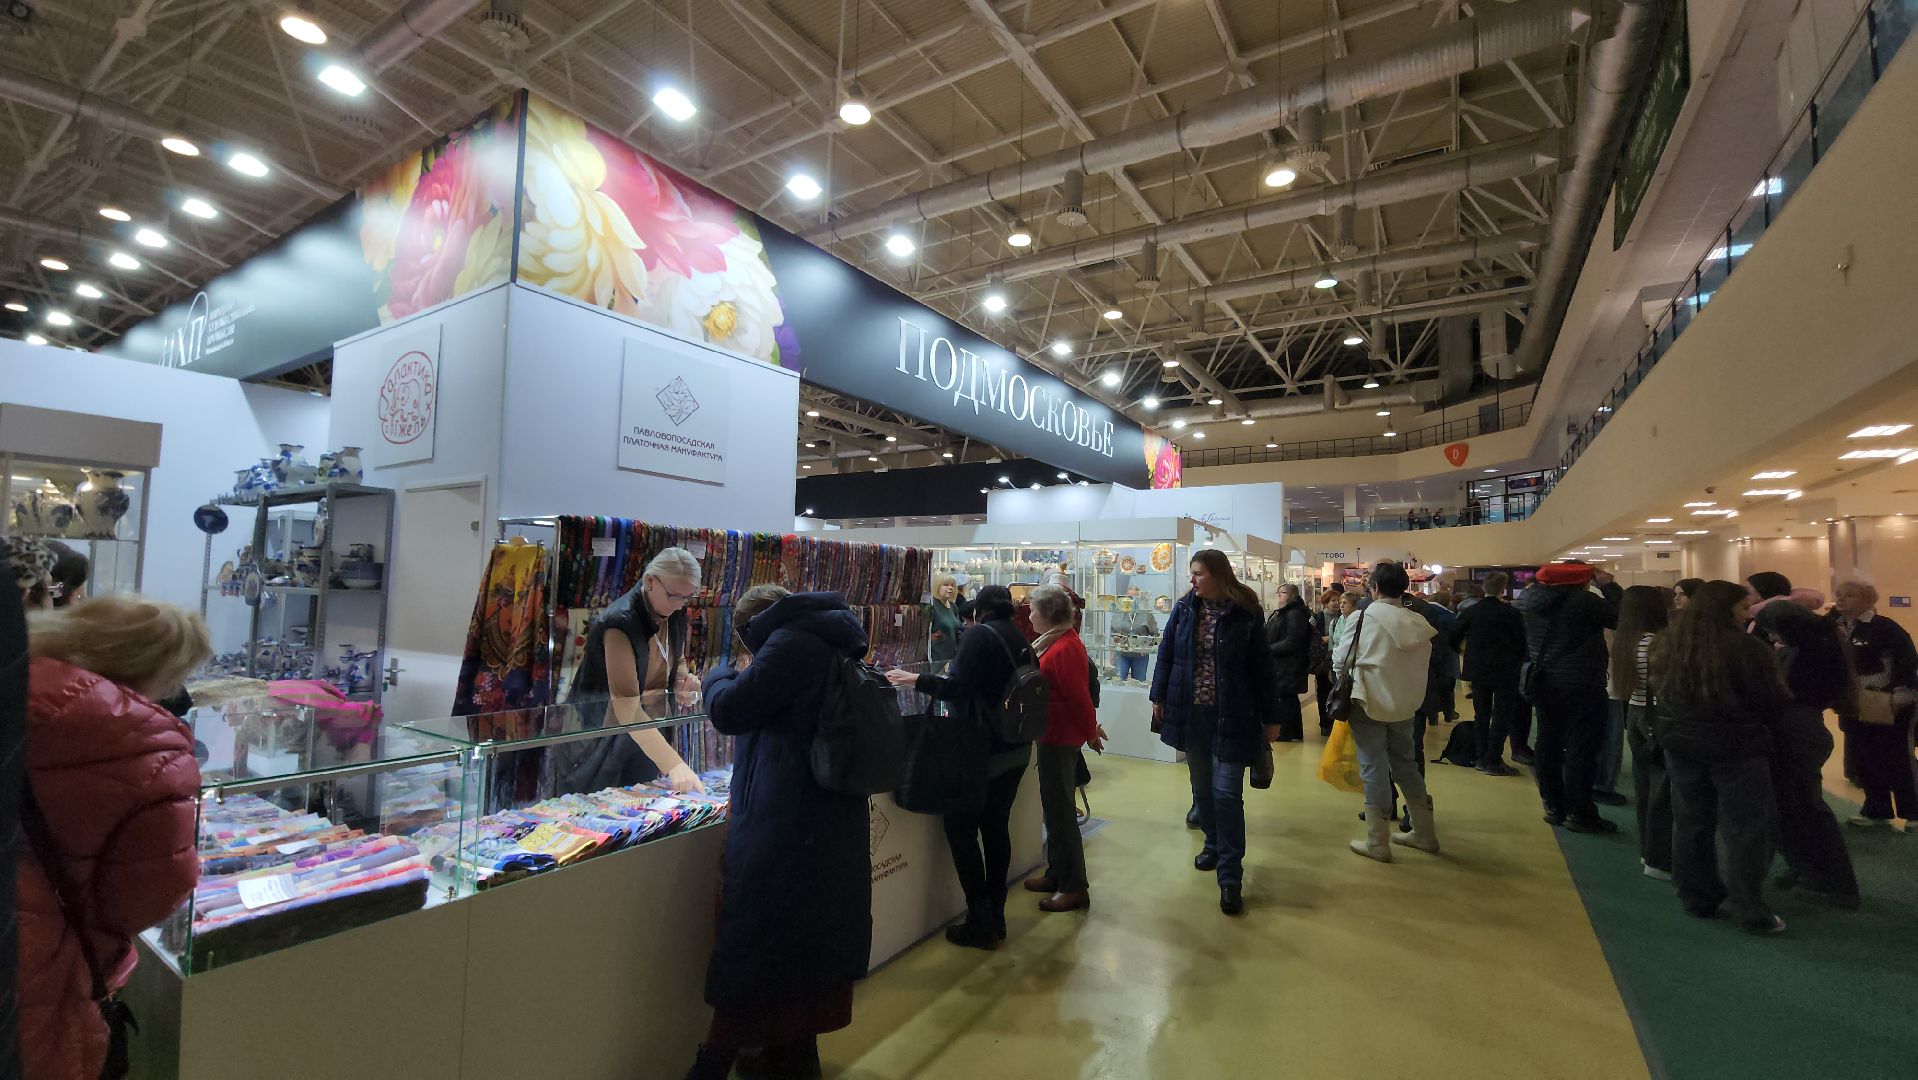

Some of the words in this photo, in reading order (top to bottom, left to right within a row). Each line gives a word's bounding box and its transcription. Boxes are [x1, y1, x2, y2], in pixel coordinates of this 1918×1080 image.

[896, 316, 1114, 458] ПОДМОСКОВЬЕ
[623, 435, 669, 452] ПЛАТОЧНАЯ
[671, 445, 723, 462] МАНУФАКТУРА
[633, 426, 715, 450] ПАВЛОВОПОСАДСКАЯ
[1453, 449, 1460, 460] D
